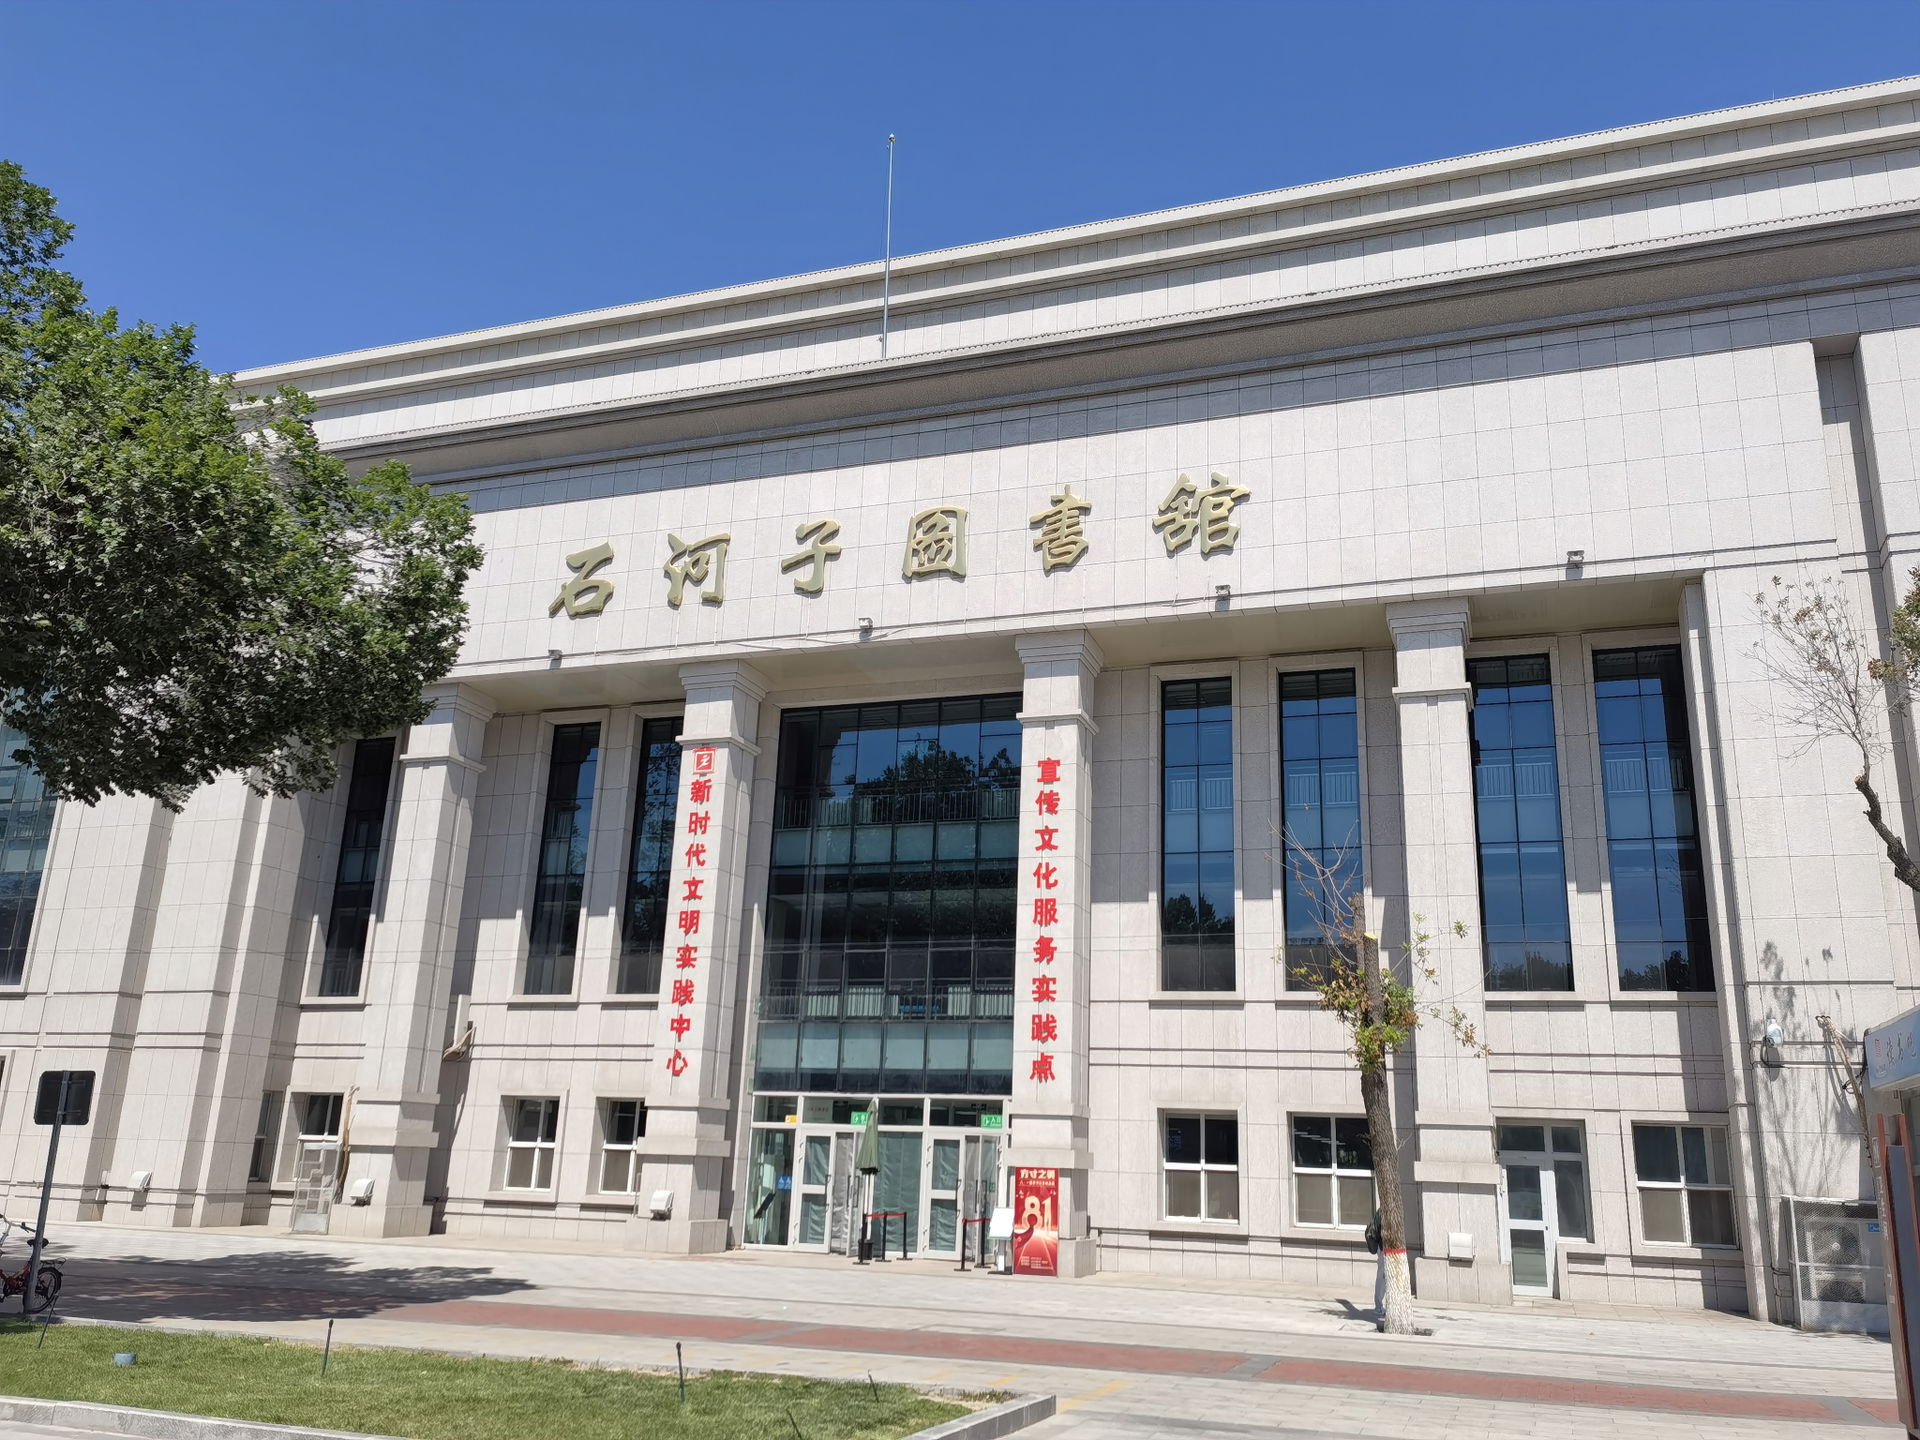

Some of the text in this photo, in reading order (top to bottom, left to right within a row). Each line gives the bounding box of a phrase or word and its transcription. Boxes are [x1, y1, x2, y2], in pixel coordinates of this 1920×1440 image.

[666, 779, 713, 1075] 新时代文明实践中心
[1030, 757, 1060, 1081] 宣传文化服务实践点
